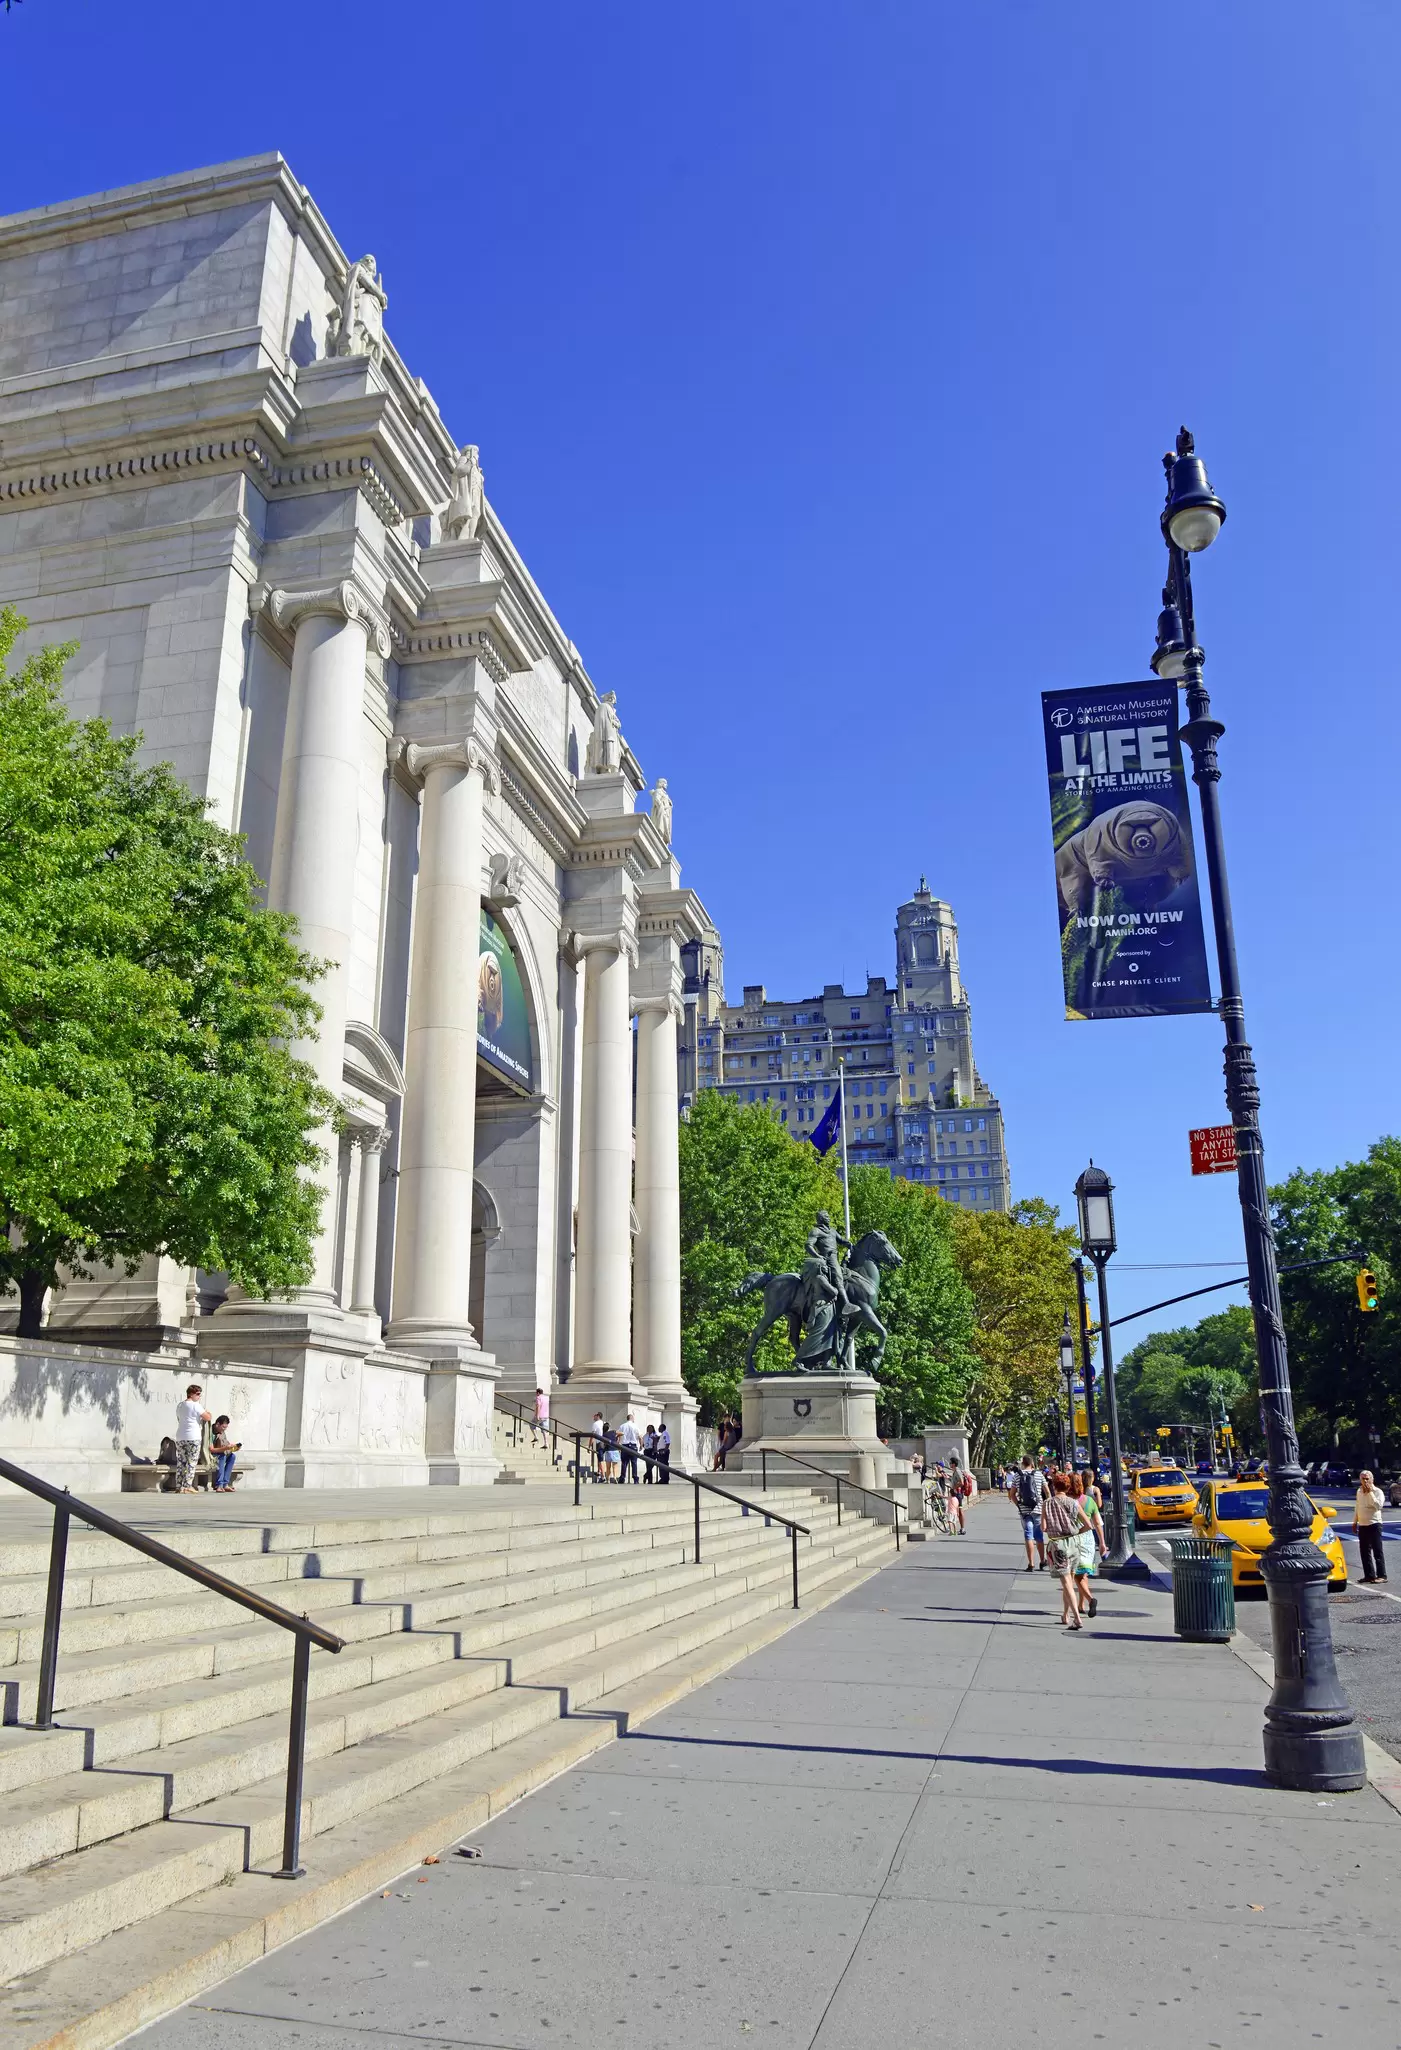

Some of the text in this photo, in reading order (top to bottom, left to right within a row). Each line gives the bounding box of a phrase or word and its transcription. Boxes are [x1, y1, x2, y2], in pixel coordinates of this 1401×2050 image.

[1077, 698, 1172, 715] AMERICAN MUSEUM
[1084, 714, 1128, 724] NATURAL
[1129, 709, 1169, 720] HISTORY
[1060, 725, 1171, 778] LIFE
[1065, 770, 1173, 791] AT THE LIMITS
[1107, 785, 1142, 793] AMAZING
[1144, 782, 1173, 790] SPECIES
[1077, 911, 1184, 928] NOW ON VIEW
[1105, 927, 1157, 937] AMNH.ORG
[1092, 980, 1116, 988] CHASE
[1154, 976, 1181, 984] CLIENT
[1194, 1128, 1235, 1141] NO STAN
[1202, 1138, 1236, 1151] ANYTI
[1199, 1148, 1237, 1160] TAXI STA
